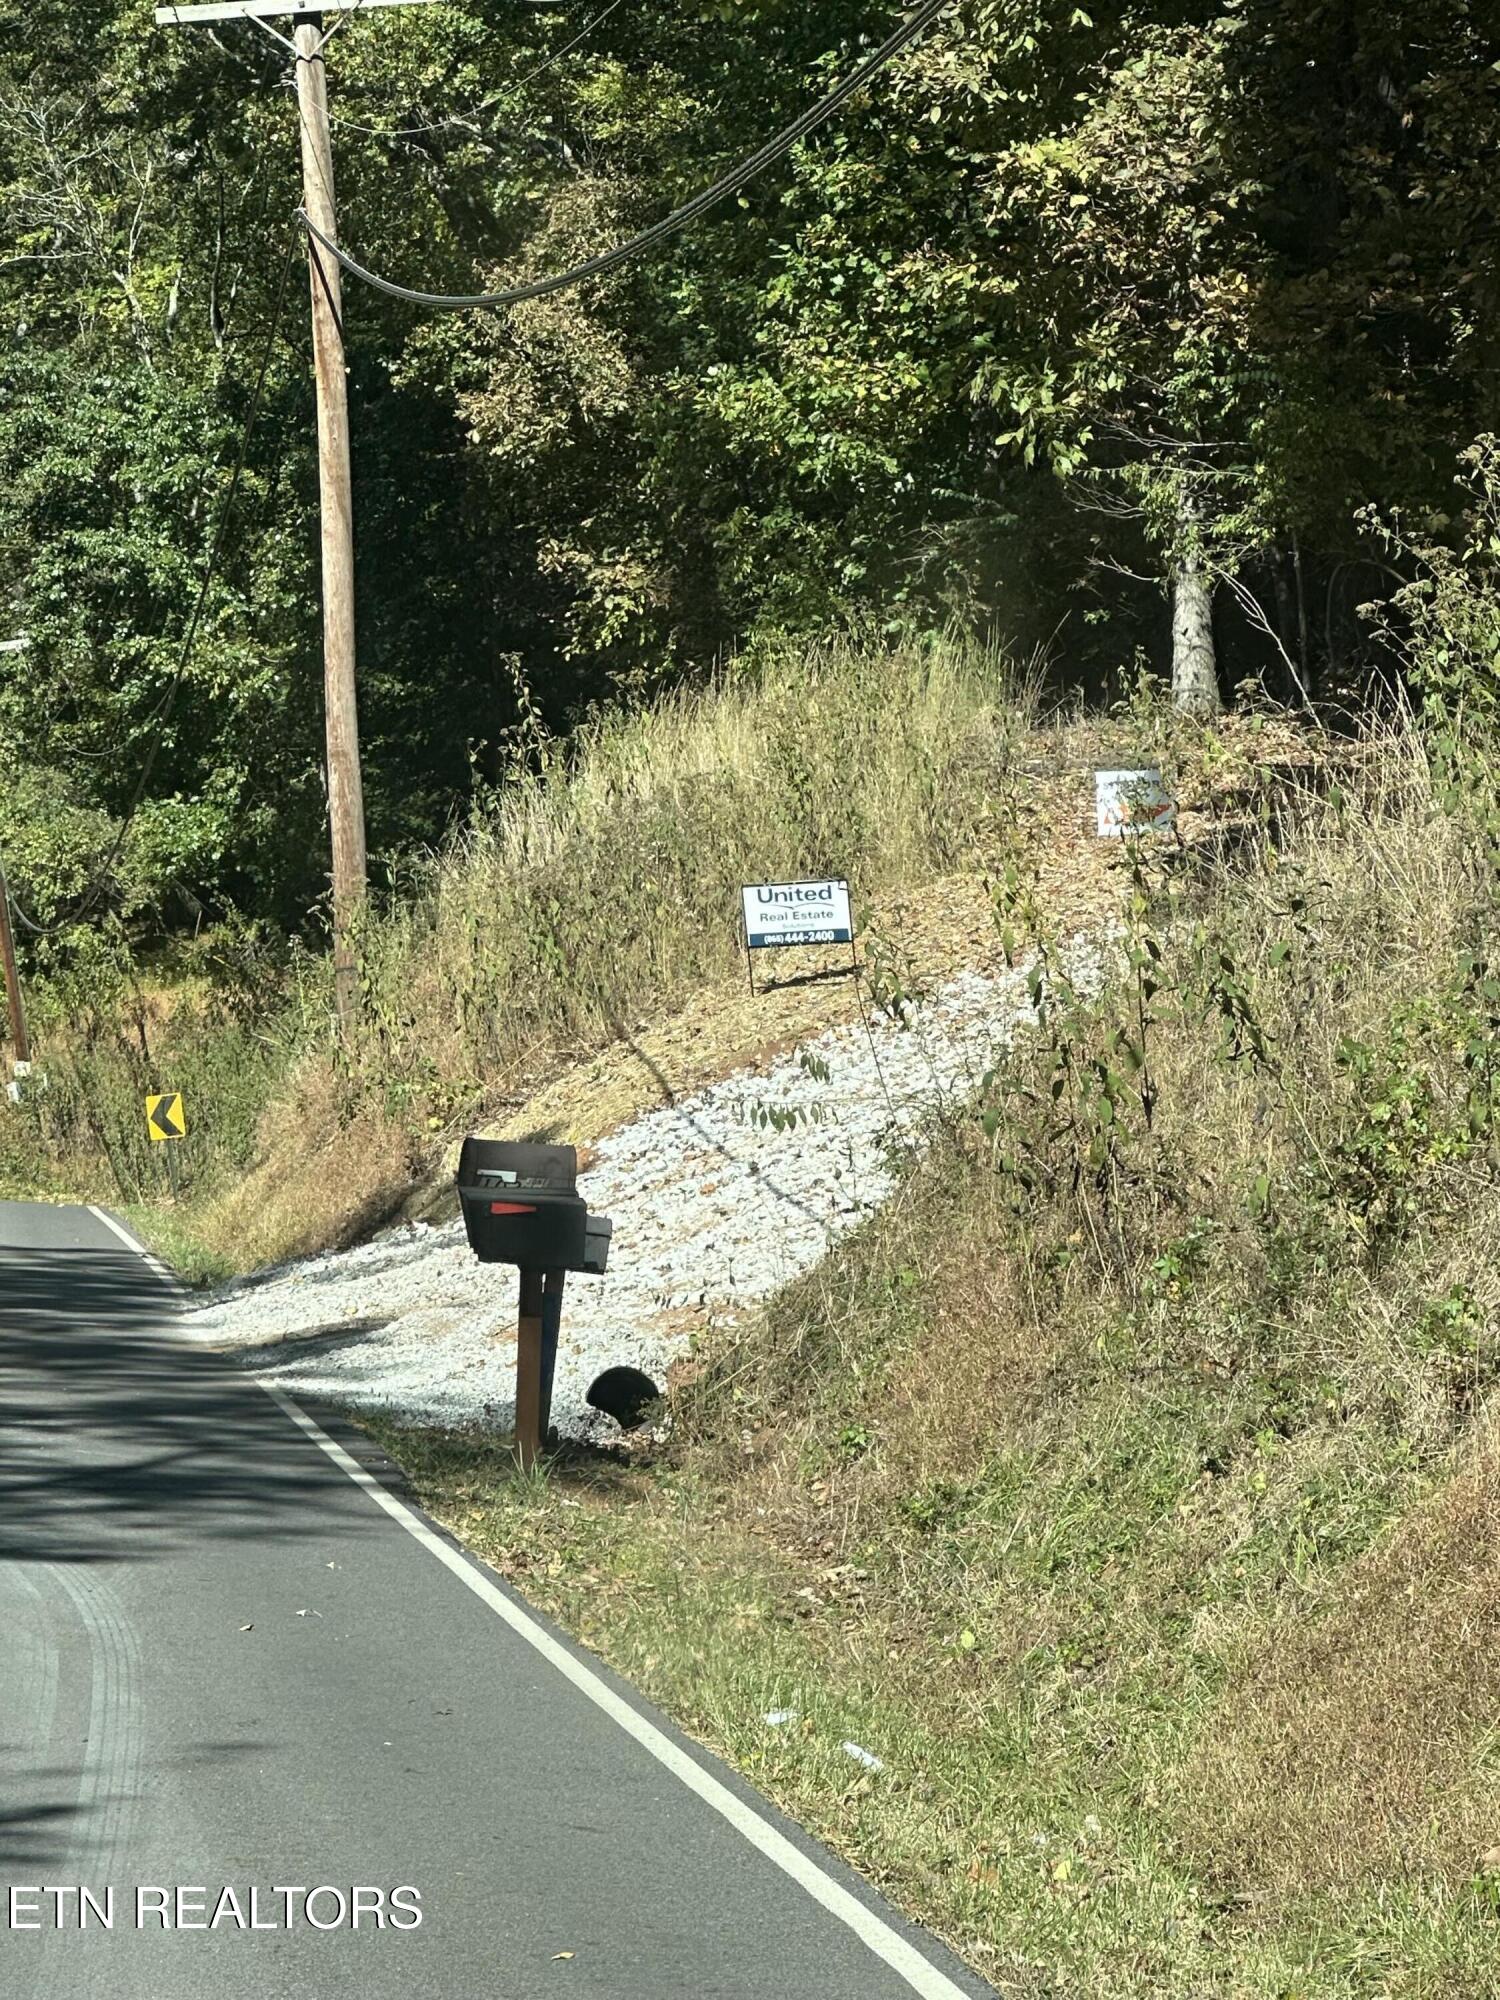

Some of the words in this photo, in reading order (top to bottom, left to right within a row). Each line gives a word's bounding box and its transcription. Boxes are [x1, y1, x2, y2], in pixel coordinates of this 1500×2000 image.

[757, 884, 833, 904] United
[760, 911, 788, 922] Real
[792, 910, 834, 921] Estate
[785, 930, 835, 943] 444-2400
